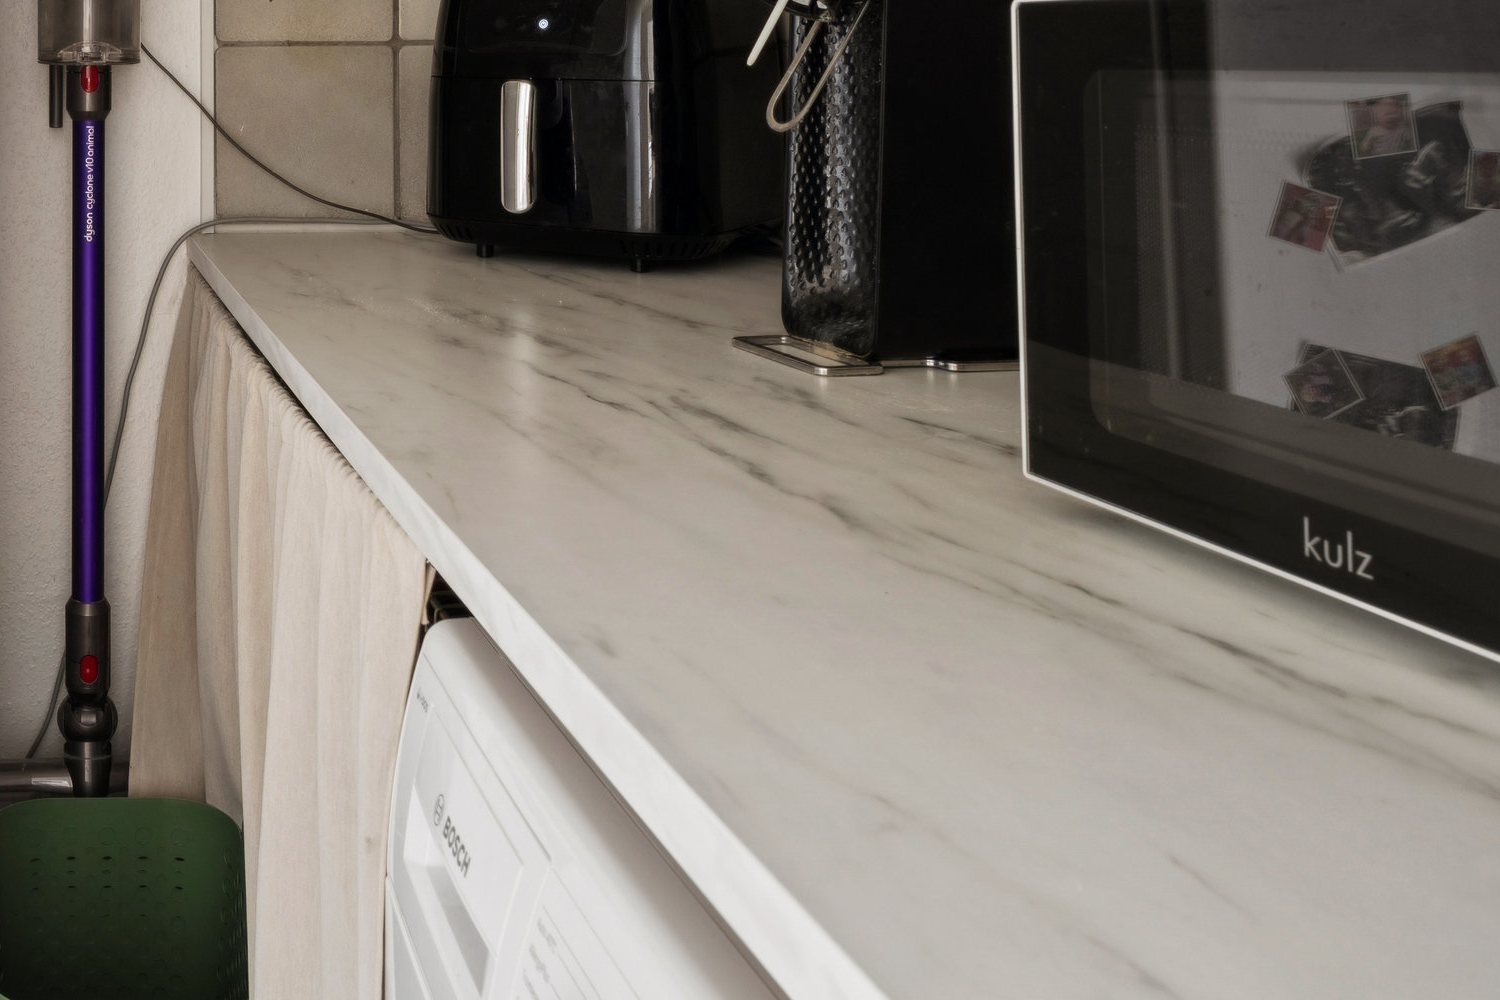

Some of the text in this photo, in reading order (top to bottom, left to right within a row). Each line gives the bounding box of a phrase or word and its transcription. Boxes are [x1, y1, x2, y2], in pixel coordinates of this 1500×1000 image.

[84, 125, 95, 242] dyson cyclone v10 animal
[1303, 516, 1374, 580] kulz
[442, 815, 471, 878] BOSCH
